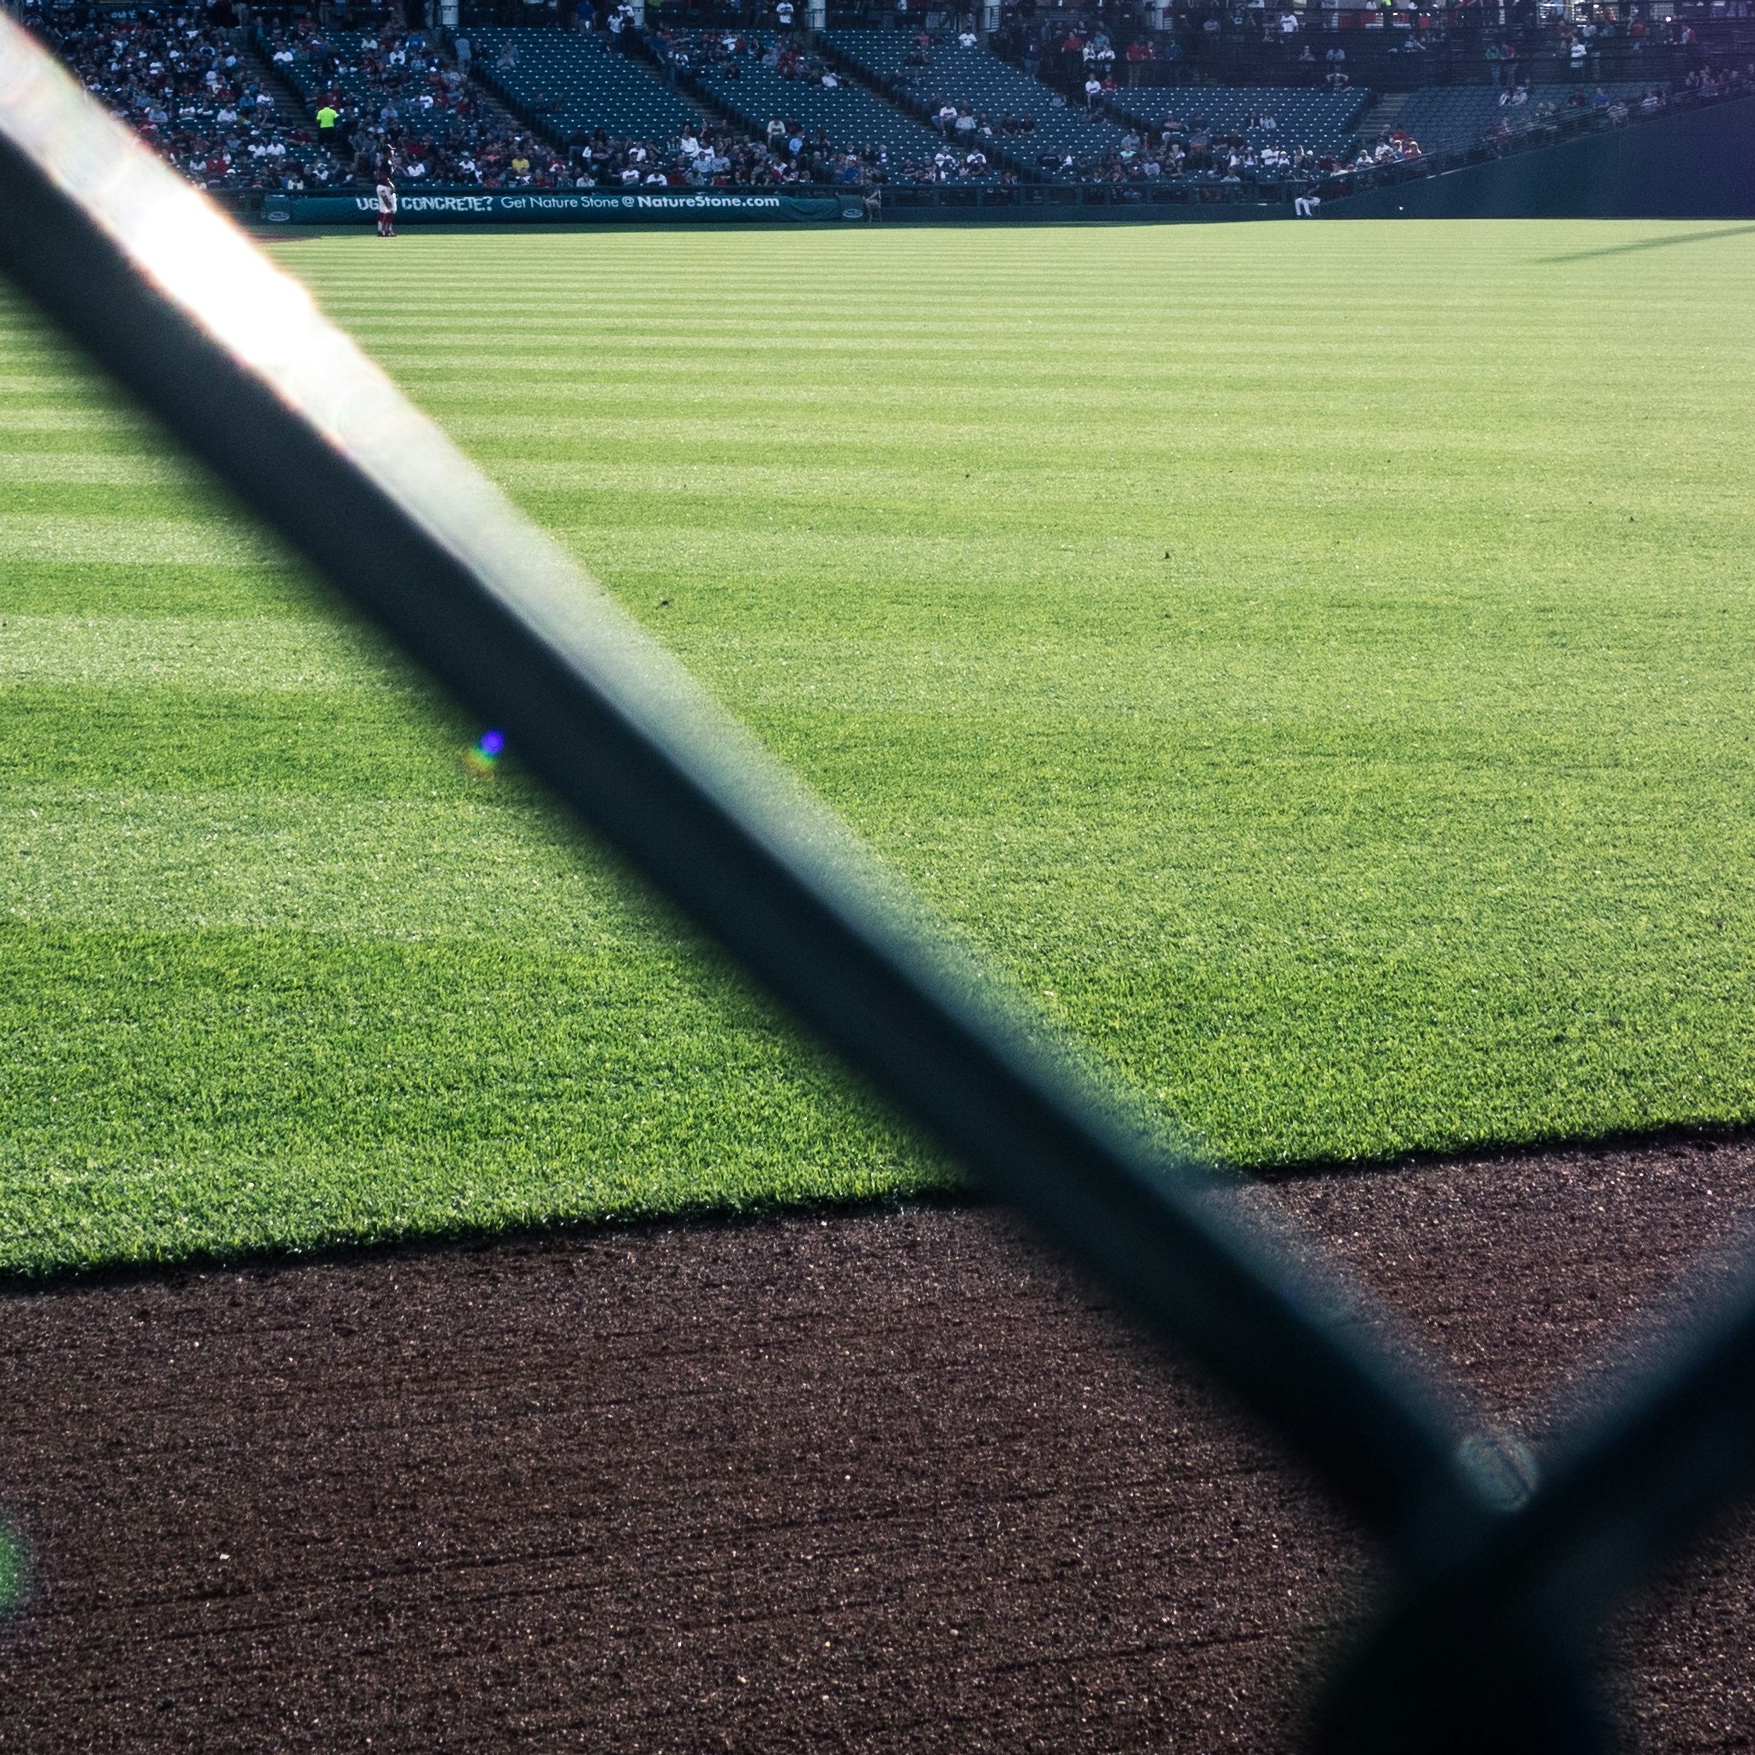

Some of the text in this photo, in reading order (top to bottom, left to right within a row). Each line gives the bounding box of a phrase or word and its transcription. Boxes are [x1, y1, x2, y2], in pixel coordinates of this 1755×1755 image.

[401, 197, 493, 211] CONCRETE?
[501, 195, 780, 209] Get Nature Stone @ NatureStone.com
